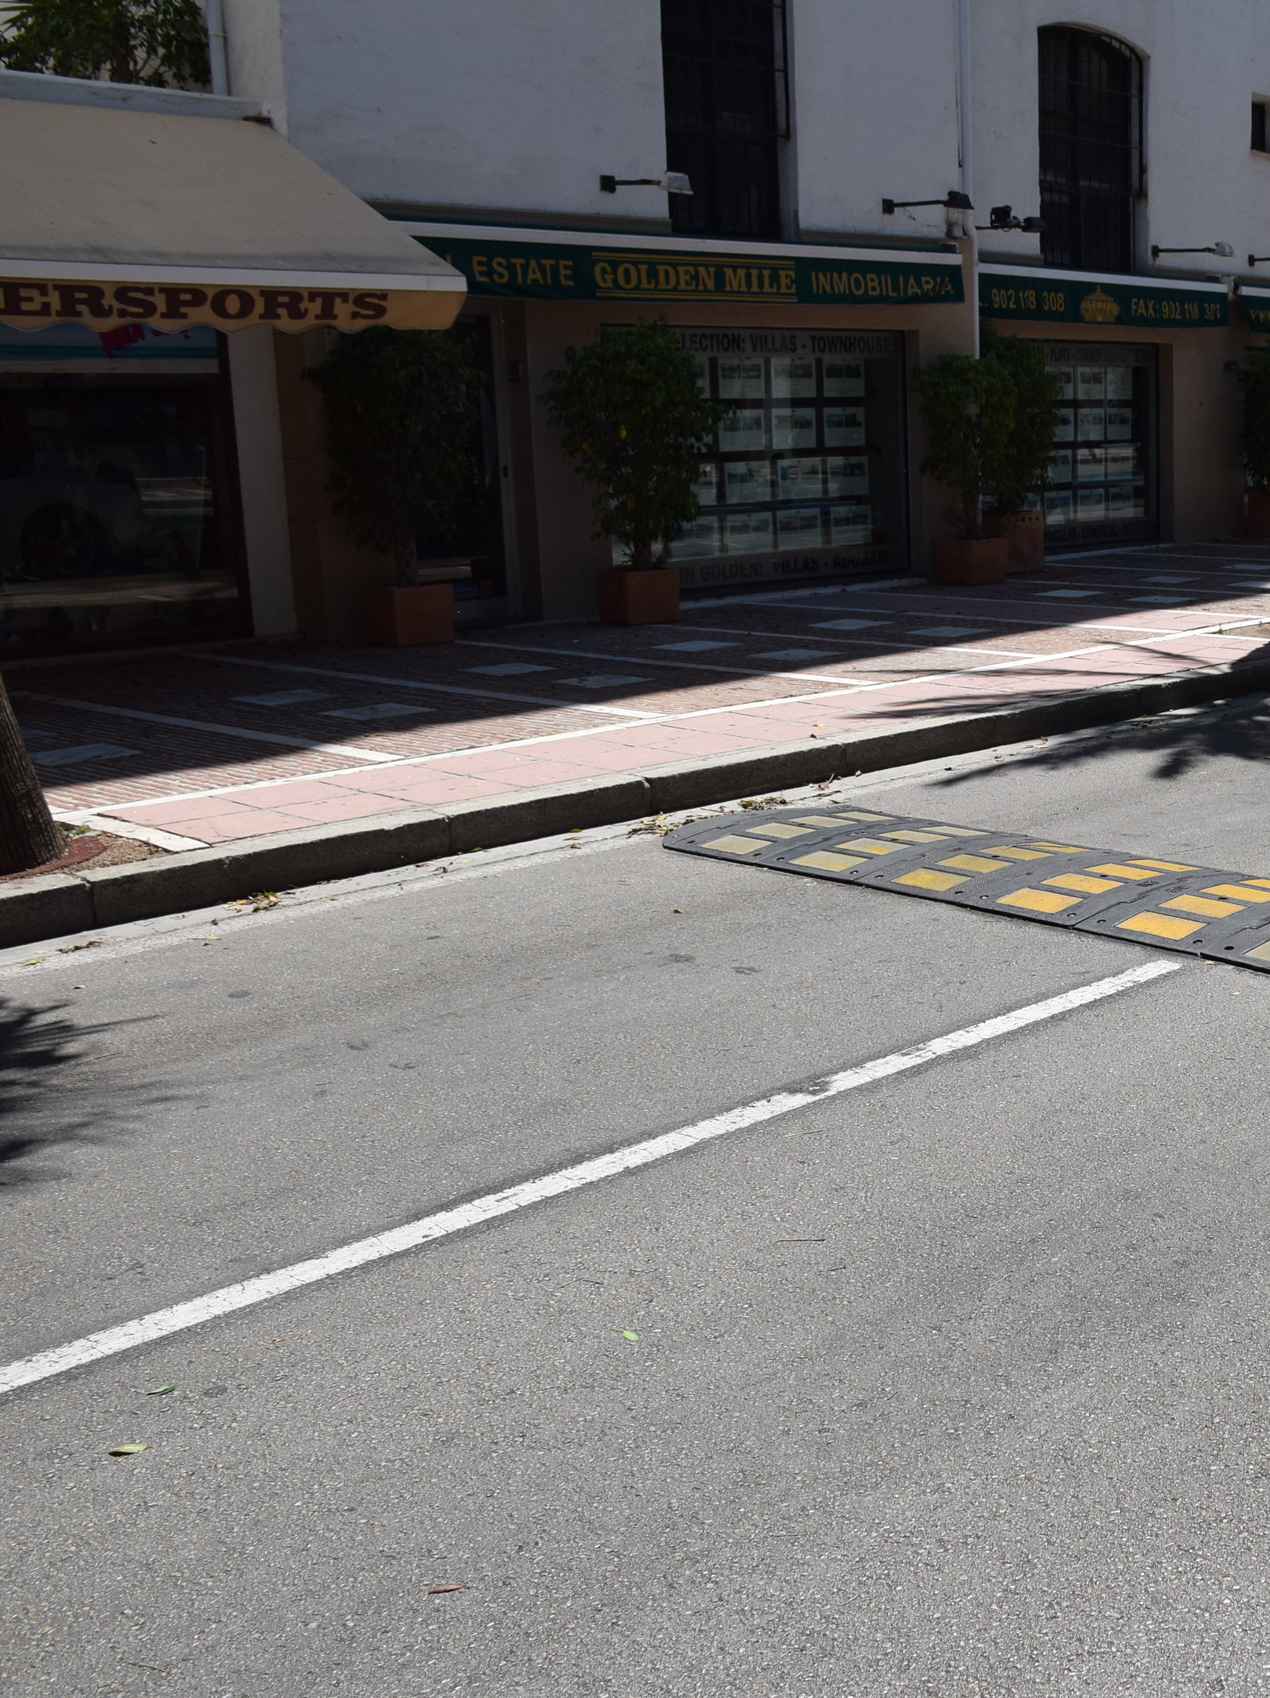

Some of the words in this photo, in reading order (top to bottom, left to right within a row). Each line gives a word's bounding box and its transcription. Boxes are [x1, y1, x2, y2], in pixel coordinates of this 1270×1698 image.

[472, 255, 575, 286] ESTATE
[593, 261, 715, 292] GOLDEN
[723, 266, 797, 294] MILE
[811, 270, 955, 298] INMOBILIARIA
[991, 288, 1016, 309] 902
[1018, 289, 1036, 309] 118
[1042, 291, 1065, 312] 308
[1131, 297, 1159, 318] FAX:
[1161, 299, 1182, 319] 902
[1184, 301, 1199, 320] 118
[749, 333, 797, 353] VILLAS
[809, 334, 898, 354] TOWNHOUSES
[700, 561, 763, 582] GOLDEN:
[772, 556, 820, 575] VILLAS
